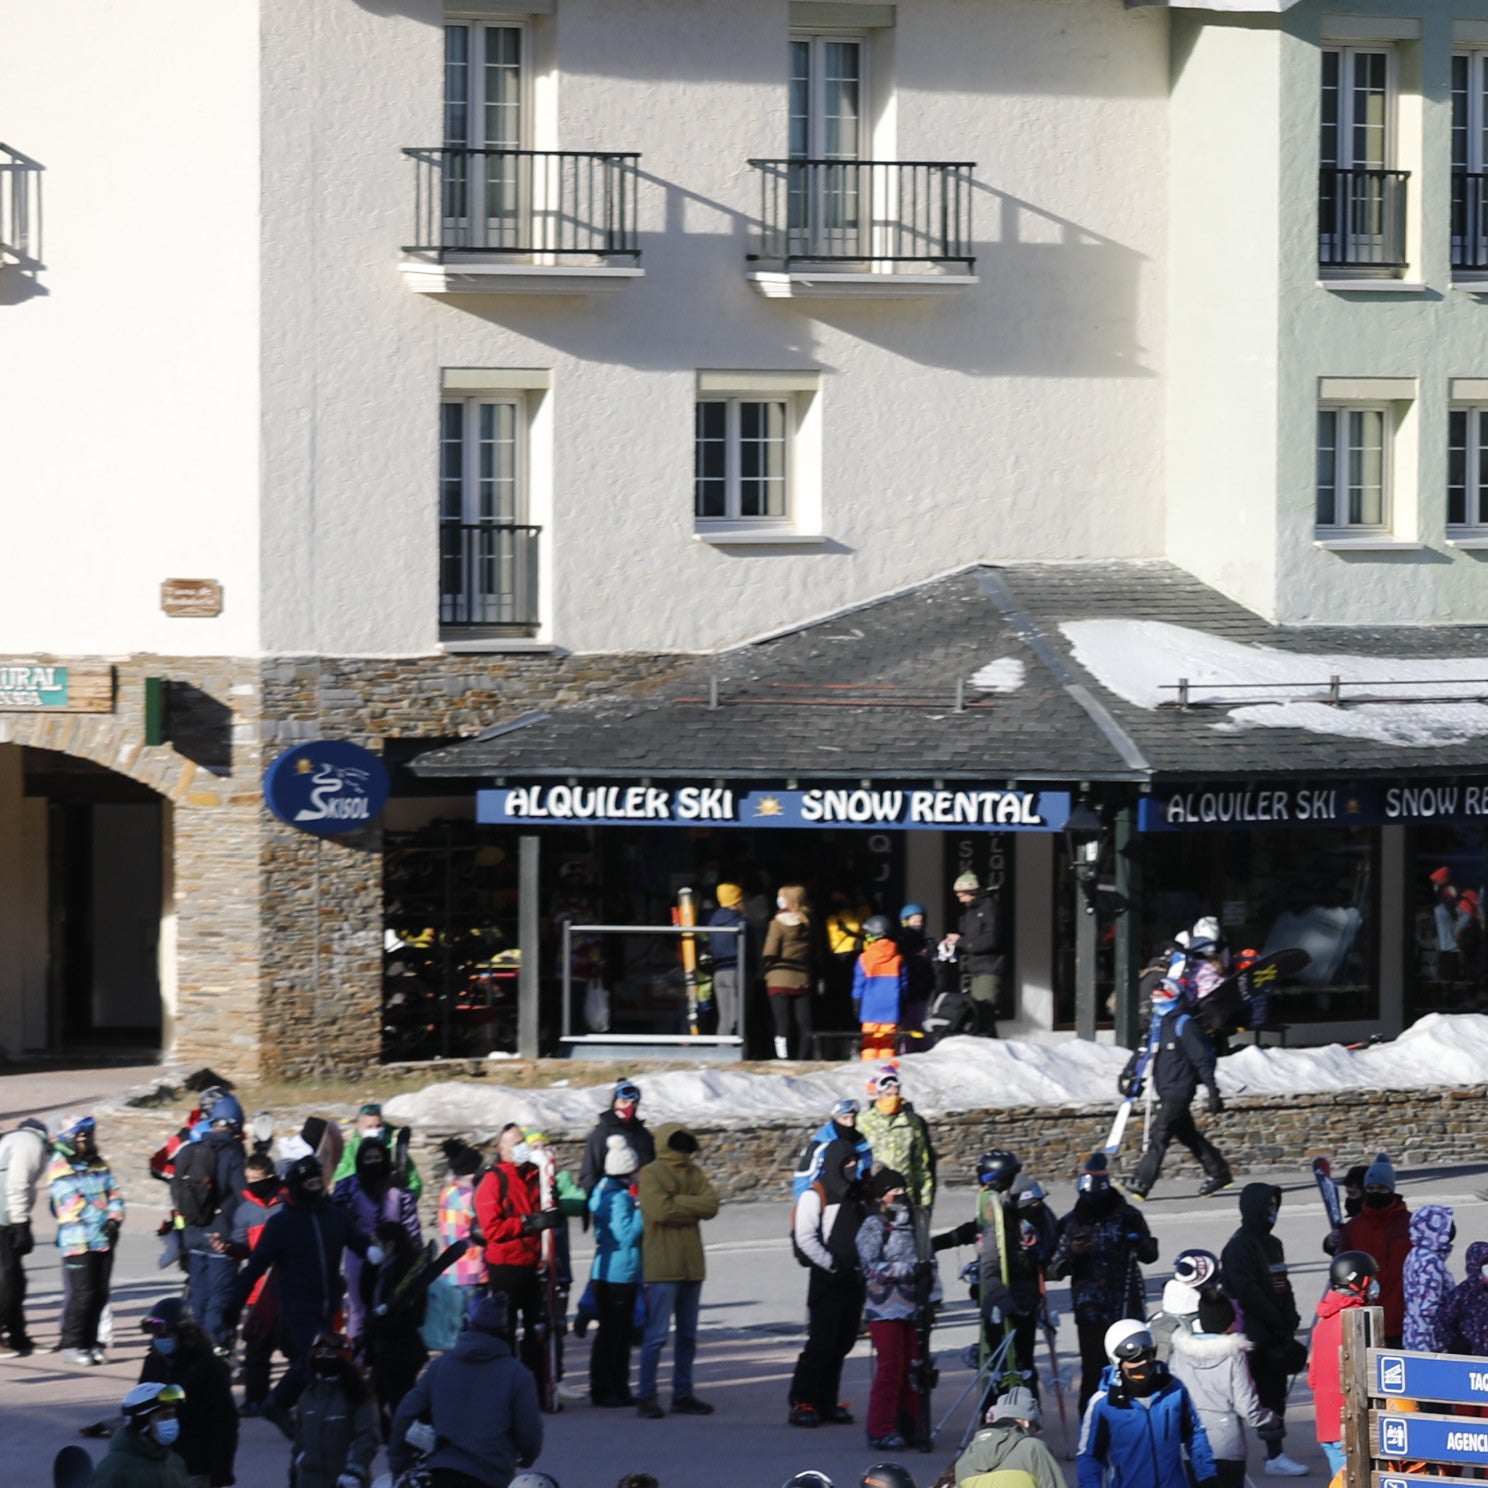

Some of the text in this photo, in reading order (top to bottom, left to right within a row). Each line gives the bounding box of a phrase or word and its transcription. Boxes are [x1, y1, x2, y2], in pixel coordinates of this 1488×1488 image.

[504, 785, 733, 820] ALQUILER SKI
[800, 789, 1041, 825] SNOW RENTAL
[1167, 790, 1336, 823] ALQUILER SKI
[1385, 787, 1459, 818] SNOW
